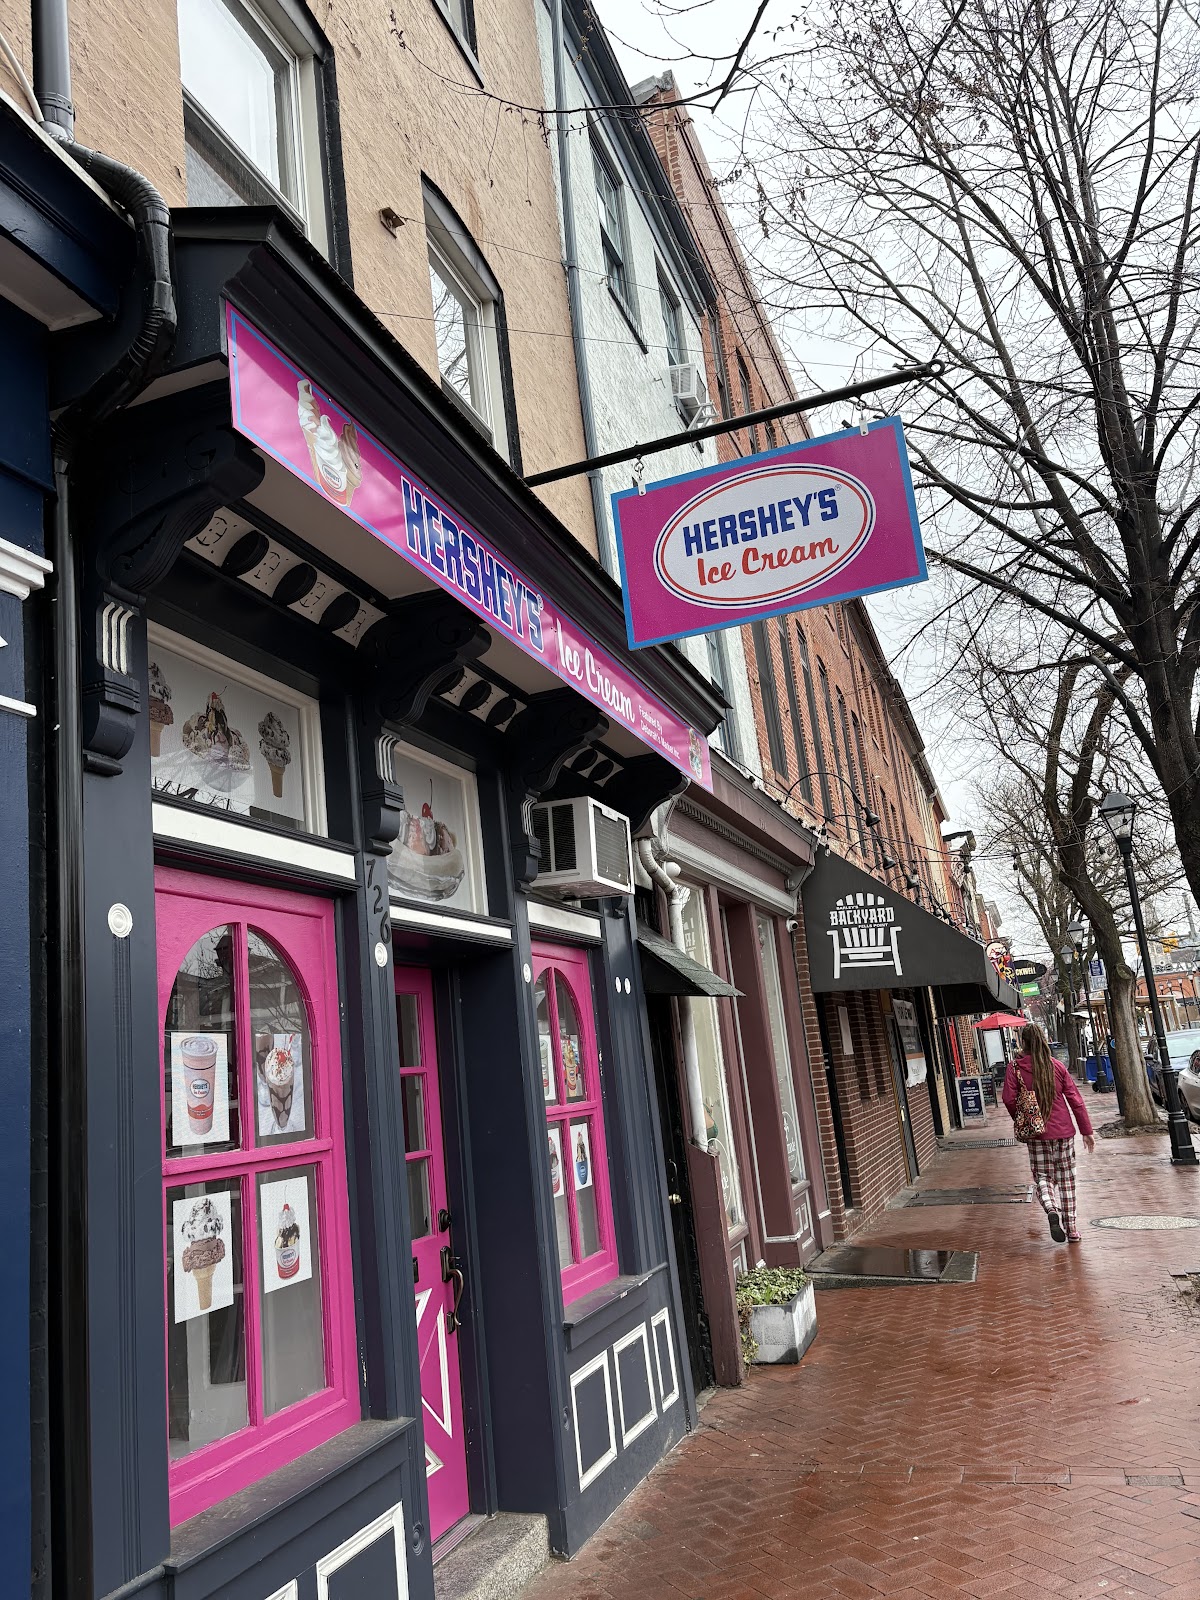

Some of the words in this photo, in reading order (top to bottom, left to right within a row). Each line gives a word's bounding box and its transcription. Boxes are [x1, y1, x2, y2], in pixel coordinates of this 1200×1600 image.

[682, 487, 839, 558] HERSHEY'S
[697, 557, 737, 587] Ice
[741, 537, 839, 576] Cream
[401, 475, 543, 653] HERSHEY'S
[556, 617, 584, 681] Ice
[585, 647, 636, 723] Cream
[366, 859, 391, 944] 726
[830, 907, 894, 926] BACKYARD
[1015, 966, 1036, 977] CKWELL
